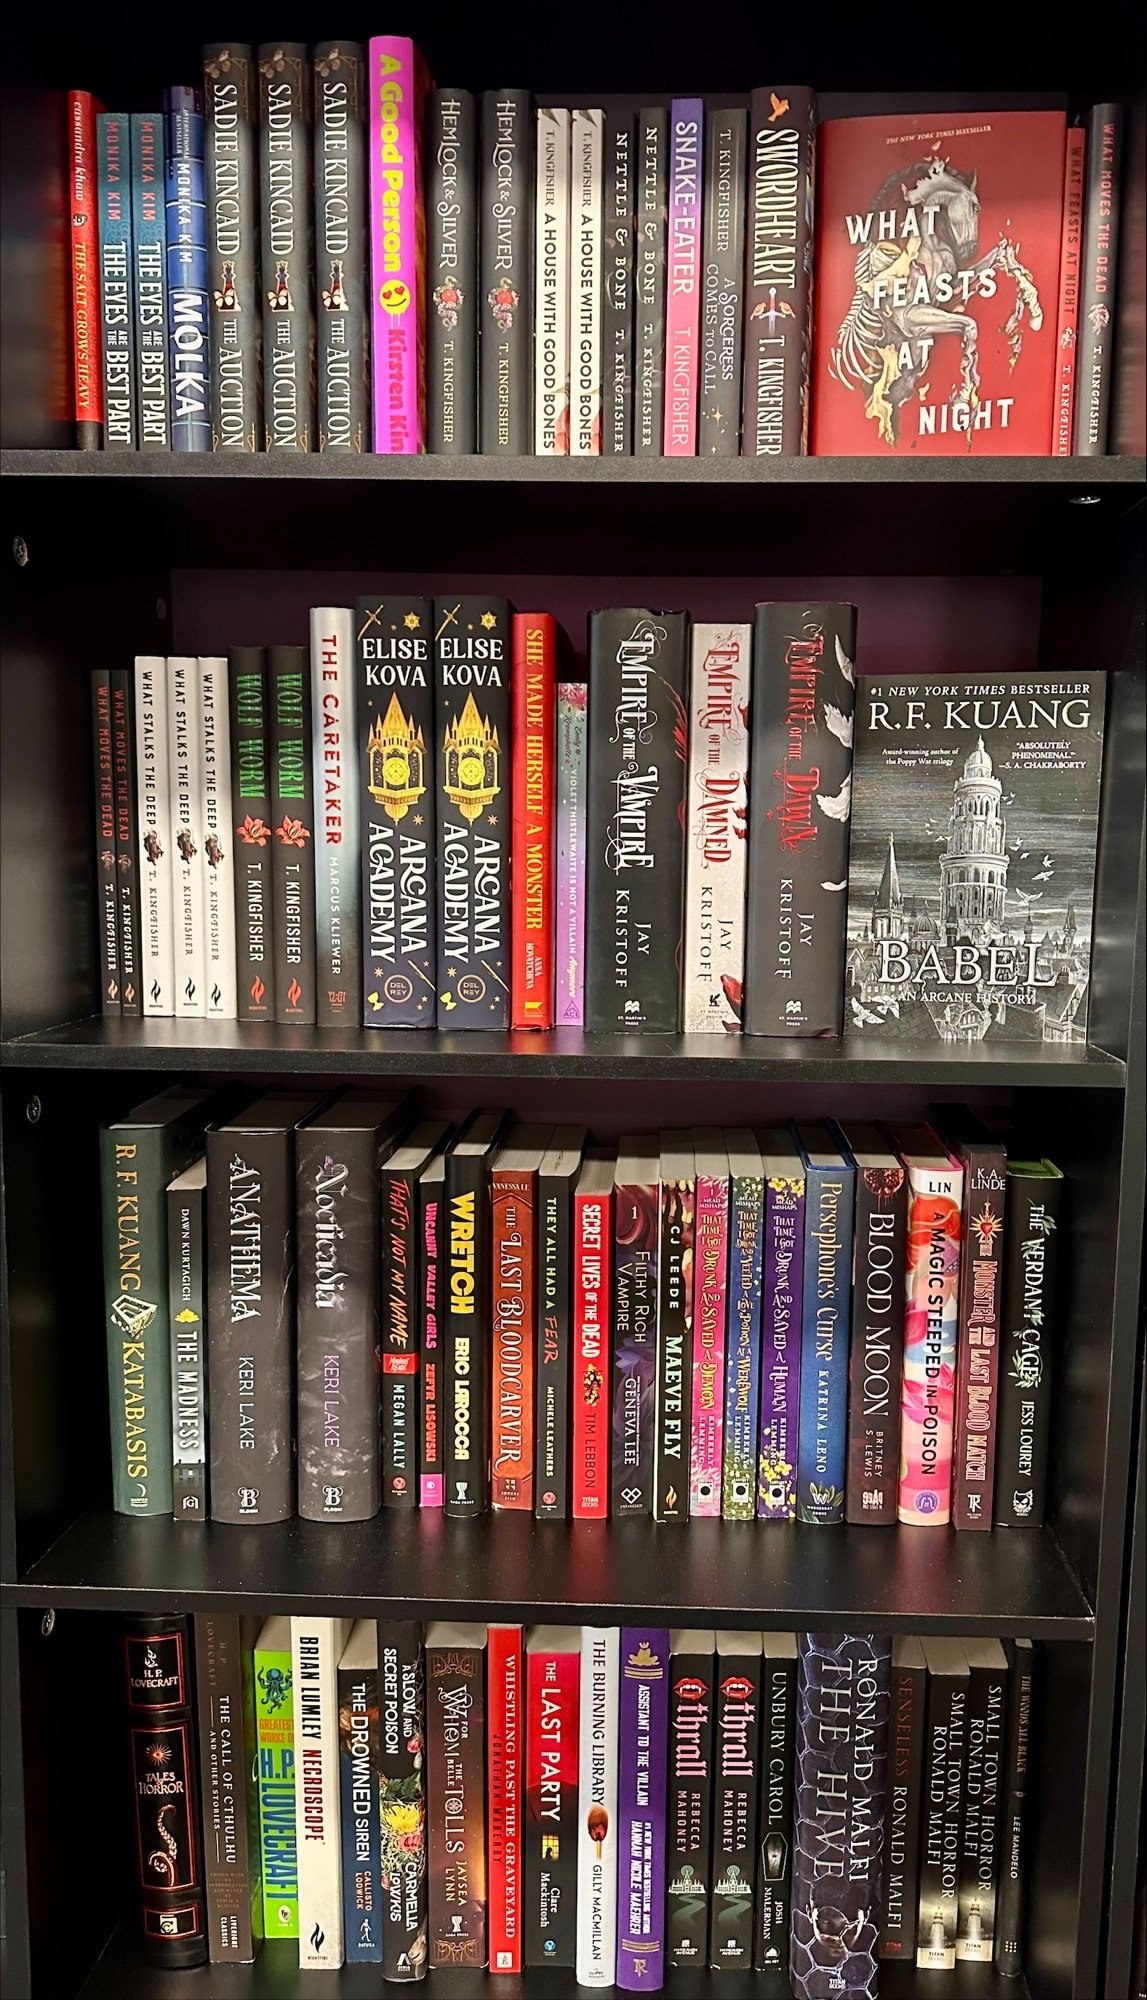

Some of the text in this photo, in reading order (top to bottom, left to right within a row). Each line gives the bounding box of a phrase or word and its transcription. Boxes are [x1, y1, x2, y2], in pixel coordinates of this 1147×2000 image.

[380, 54, 401, 76] A
[74, 101, 86, 201] cassandra khaw
[214, 84, 240, 255] SADIE KINCAID
[438, 99, 460, 269] HEMLOCK & SILVER
[1102, 123, 1114, 164] WHAT
[672, 121, 697, 296] SNAKE-EATER
[753, 128, 799, 289] SWORDHEART
[846, 206, 941, 245] WHAT
[1098, 223, 1109, 251] THE
[544, 214, 556, 449] A HOUSE WITH GOOD BONES
[873, 268, 997, 310] FEASTS
[1096, 256, 1108, 293] DEAD
[104, 242, 131, 444] THE EYES ARE THE BEST PART
[175, 294, 205, 417] MOLKA
[219, 319, 244, 447] THE AUCTION
[388, 329, 407, 410] Kirsten
[756, 336, 785, 456] T. KINGFISHER
[900, 339, 934, 369] AT
[919, 398, 1015, 435] NIGHT
[362, 639, 428, 661] ELISE
[366, 666, 427, 687] KOVA
[870, 683, 1090, 696] #1 NEW YORK TIMES BESTSELLER
[143, 672, 156, 826] WHAT STALKS THE DEEP
[239, 739, 265, 798] WORM
[321, 636, 342, 845] THE CARETAKER
[868, 700, 1090, 731] R.F. KUANG
[525, 629, 544, 929] SHE MADE HERSELF A MONSTER
[328, 857, 341, 976] MARCUS KLIEWER
[368, 822, 395, 963] ACADEMY
[399, 835, 428, 954] ARCANA
[615, 889, 630, 988] KRISTOFF
[634, 922, 652, 956] JAY
[877, 940, 1057, 988] BABEL
[898, 992, 1035, 1005] AN ARCANE HISTORY
[116, 1144, 142, 1291] R. F. KUANG
[229, 1154, 262, 1323] ANATHEMA
[929, 1182, 952, 1193] LIN
[449, 1192, 475, 1314] WRETCH
[582, 1204, 601, 1359] SECRET LIVES OF THE DEAD
[617, 1264, 632, 1331] VAMPIRE
[634, 1251, 651, 1343] FILTHY RICH
[493, 1206, 525, 1469] THE LAST BLOODCARVER
[816, 1307, 839, 1361] Curse
[863, 1212, 896, 1417] BLOOD MOON
[922, 1212, 945, 1475] A MAGIC STEEPED IN POISON
[123, 1342, 148, 1479] KATABASIS
[177, 1332, 199, 1449] THE MADNESS
[238, 1357, 255, 1449] KERI LAKE
[454, 1337, 470, 1460] ERIC LAROCCA
[666, 1336, 682, 1459] MAEVE FLY
[1018, 1401, 1035, 1477] JESS LOUREY
[300, 1636, 322, 1740] BRIAN LUMLEY
[384, 1648, 399, 1754] SECRET POISON
[540, 1662, 561, 1822] THE LAST PARTY
[592, 1640, 607, 1806] THE BURNING LIBRARY
[636, 1684, 650, 1806] ASSISTANT TO THE VILLAIN
[672, 1702, 709, 1778] thrall
[139, 1781, 184, 1795] HORROR
[145, 1772, 175, 1782] TALES
[219, 1696, 236, 1863] THE CALL OF CTHULHU
[303, 1749, 325, 1841] NECROSCOPE
[352, 1683, 371, 1861] THE DROWNED SIREN
[504, 1654, 516, 1939] WHISTLING PAST THE GRAVEYARD
[768, 1672, 786, 1826] UNBURY CAROL
[812, 1659, 852, 1878] THE HIVE
[850, 1659, 878, 1882] RONALD MALFI
[942, 1693, 965, 1899] SMALL TOWN HORROR
[592, 1865, 602, 1961] GILLY MACMILLAN
